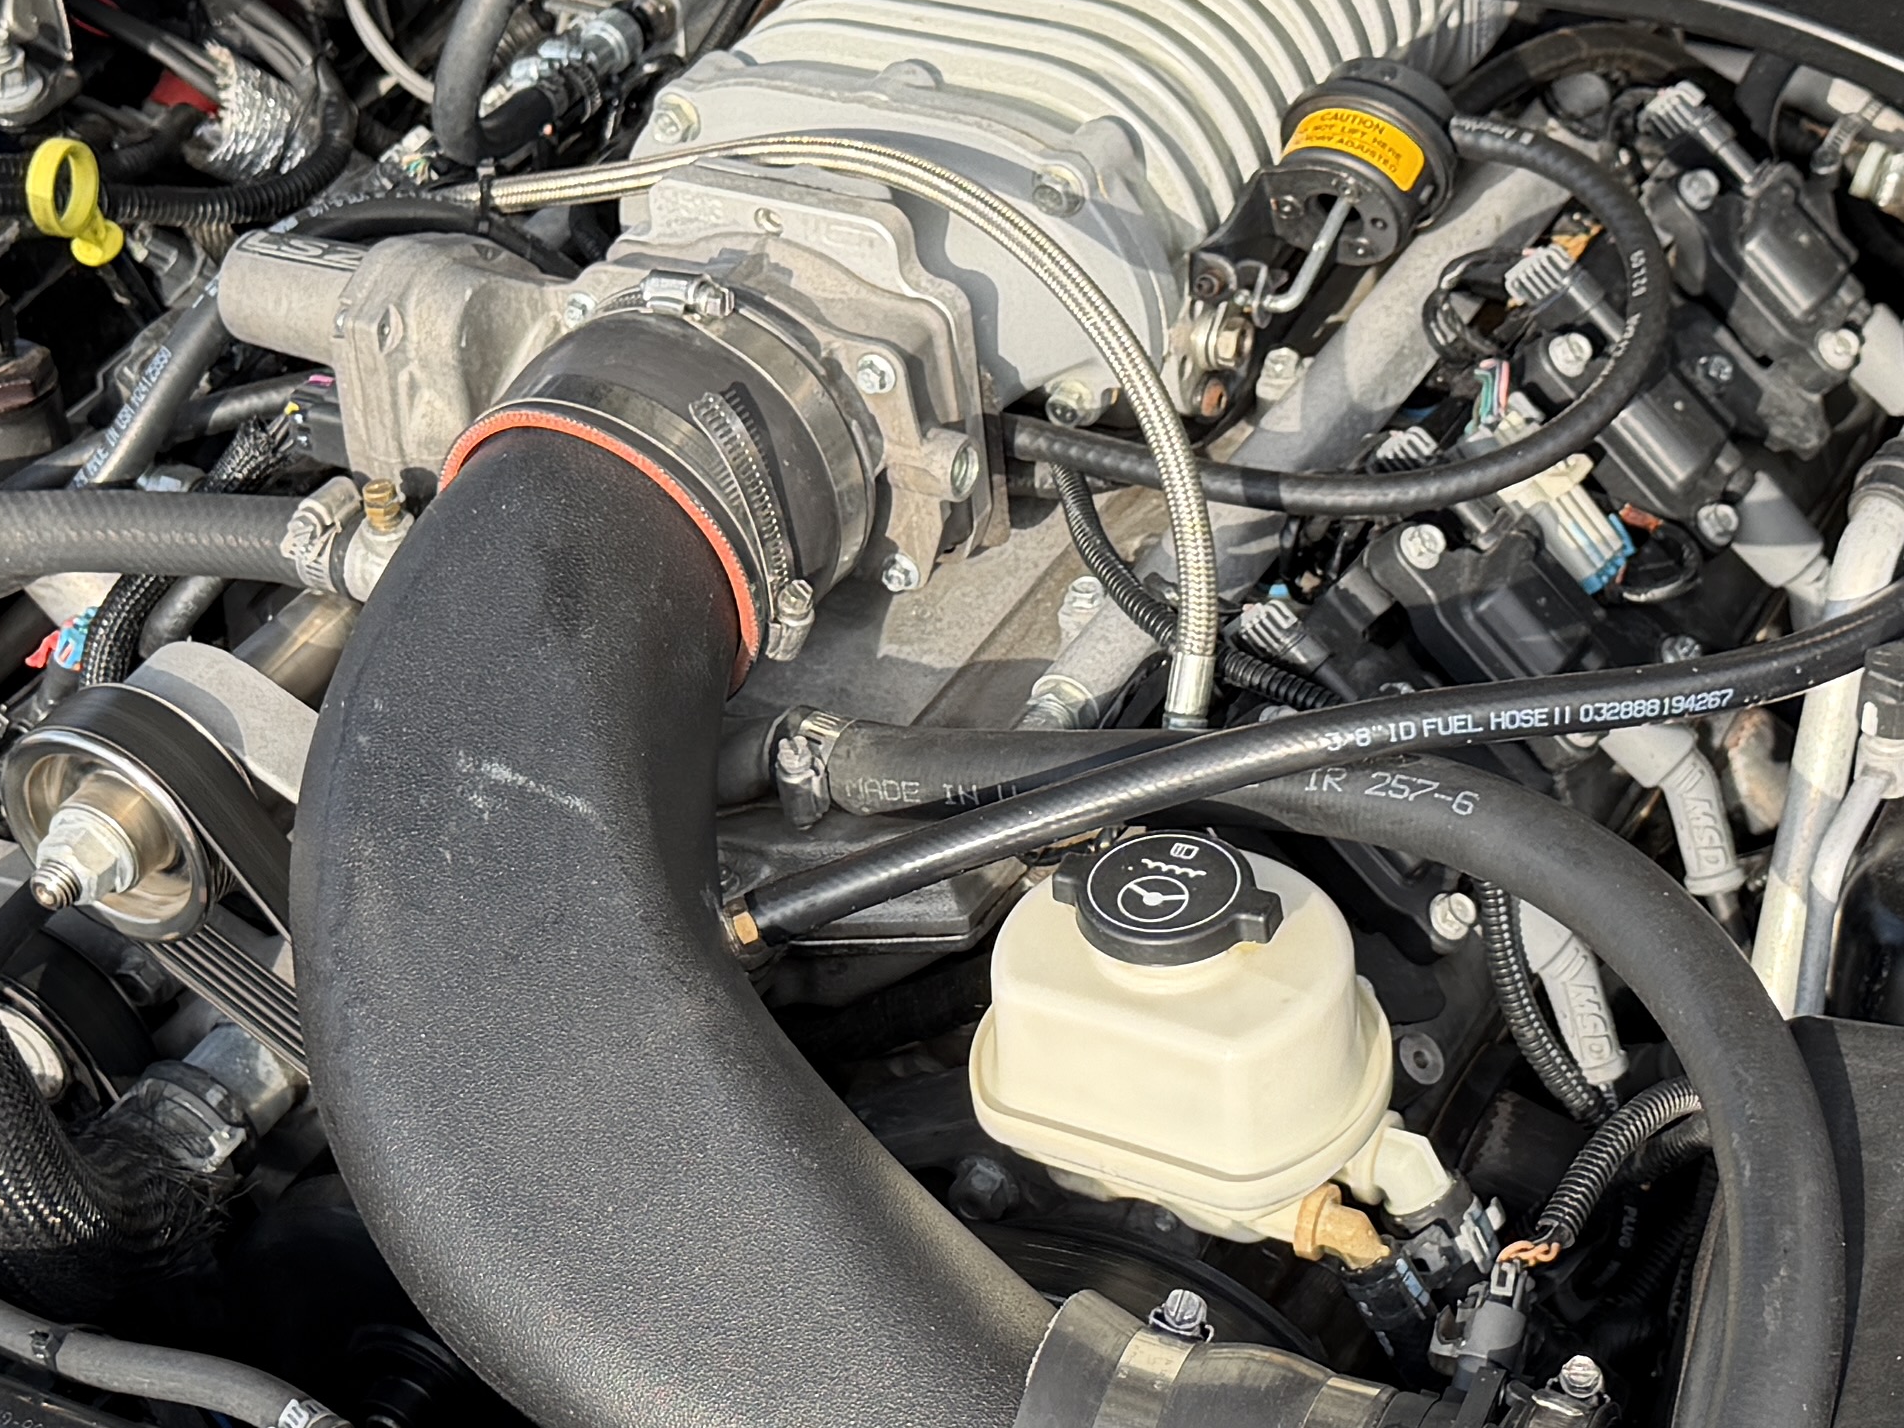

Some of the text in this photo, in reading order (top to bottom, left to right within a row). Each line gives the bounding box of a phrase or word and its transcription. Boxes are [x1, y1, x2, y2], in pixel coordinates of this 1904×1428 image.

[1320, 111, 1386, 136] CAUTION
[1336, 137, 1399, 174] ADJUSTED
[1388, 720, 1418, 743] ID
[1422, 713, 1485, 739] FUEL
[1490, 706, 1550, 731] HOSE
[1579, 688, 1735, 723] 032888194267
[846, 777, 921, 803] MADE
[942, 783, 980, 806] IN
[1364, 771, 1481, 816] 257-6
[1684, 797, 1728, 869] MSD
[1569, 983, 1613, 1063] MSD
